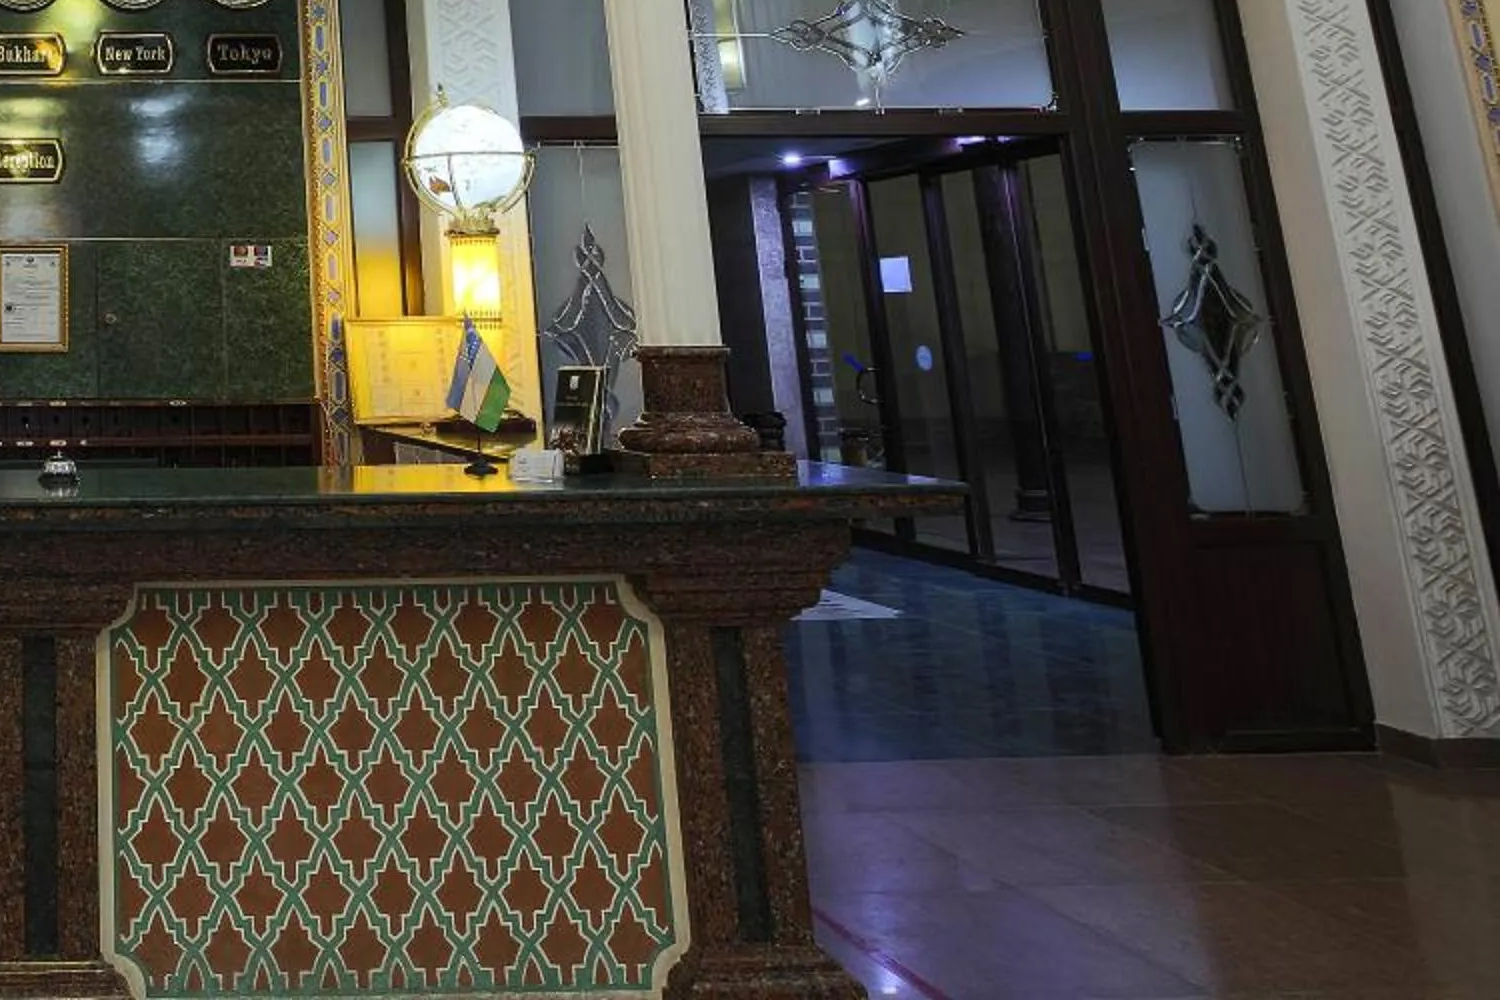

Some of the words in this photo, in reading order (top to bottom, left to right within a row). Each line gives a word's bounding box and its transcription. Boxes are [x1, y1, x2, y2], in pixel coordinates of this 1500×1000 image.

[105, 46, 133, 62] New
[136, 46, 166, 62] York
[217, 44, 273, 65] Tokyo
